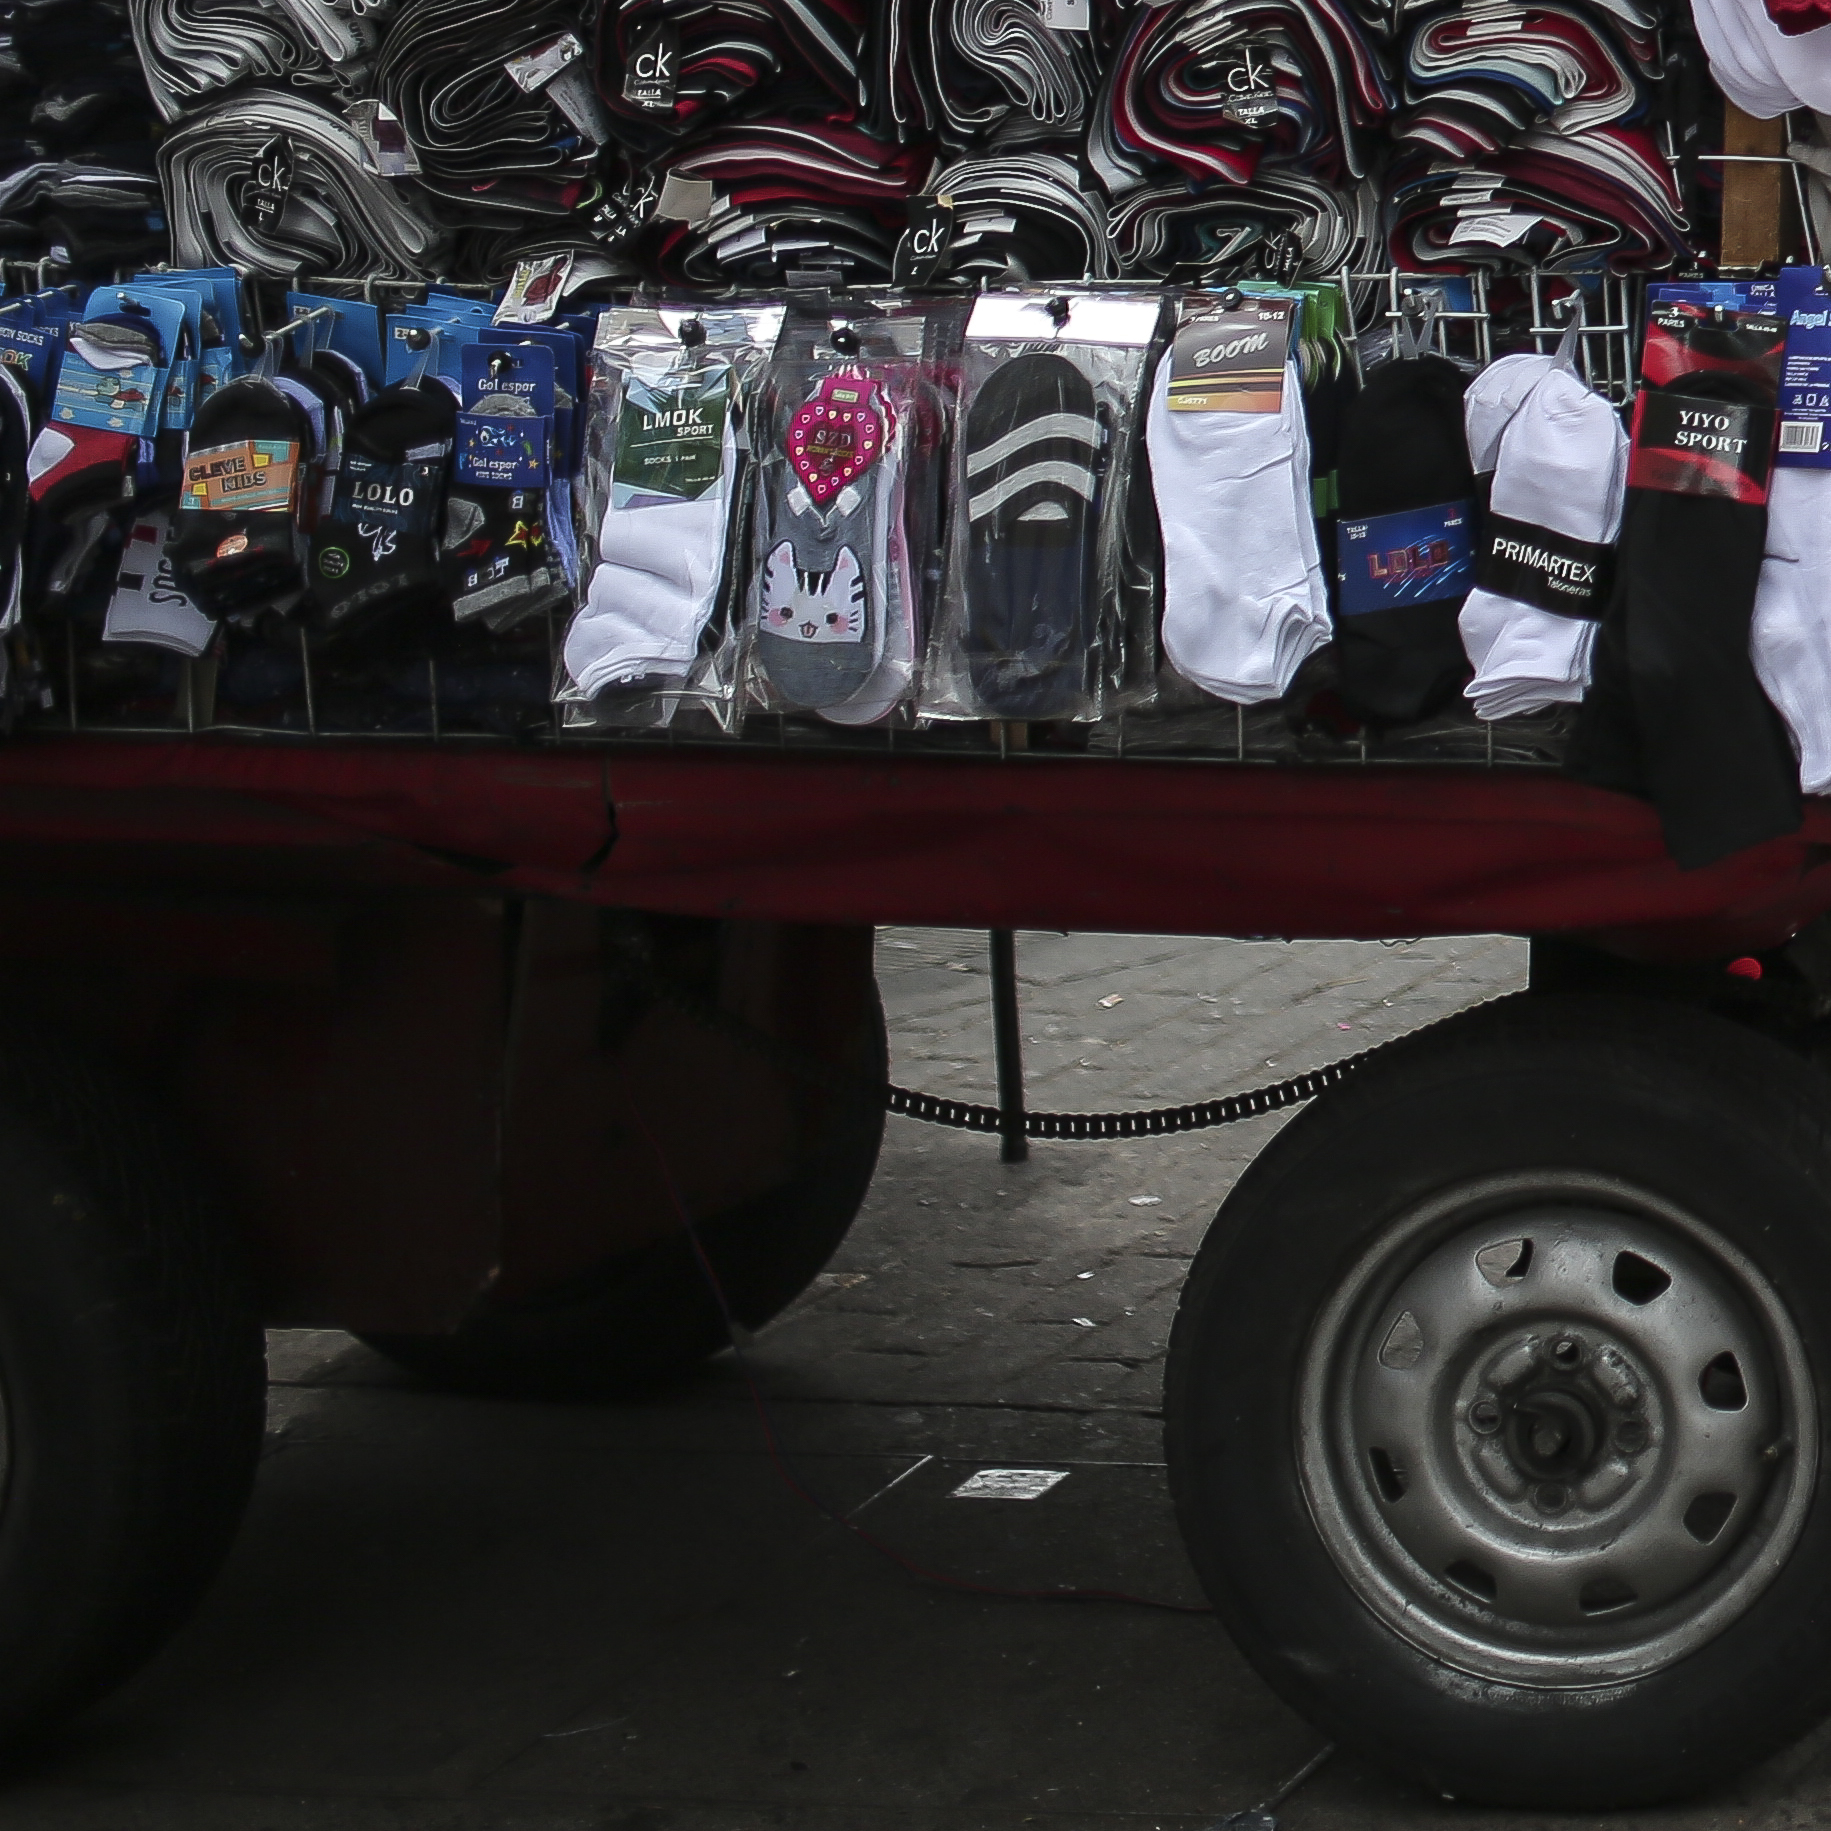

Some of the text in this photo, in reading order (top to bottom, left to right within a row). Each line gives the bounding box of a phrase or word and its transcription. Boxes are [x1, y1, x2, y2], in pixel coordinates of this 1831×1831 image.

[635, 42, 673, 78] ck
[1227, 48, 1270, 92] ck
[1237, 106, 1265, 116] TALLA
[258, 155, 286, 192] ck
[913, 218, 946, 255] ck
[1657, 317, 1686, 329] PARES
[1789, 308, 1828, 330] Angel
[1192, 331, 1270, 368] BOOM
[477, 377, 499, 392] Gol
[642, 407, 704, 431] LMOK
[676, 423, 715, 437] SPORT
[1679, 409, 1730, 431] YIYO
[1674, 431, 1748, 454] SPORT
[221, 470, 268, 494] KIDS
[351, 480, 415, 507] LOLO
[1491, 536, 1597, 584] PRIMARTEX
